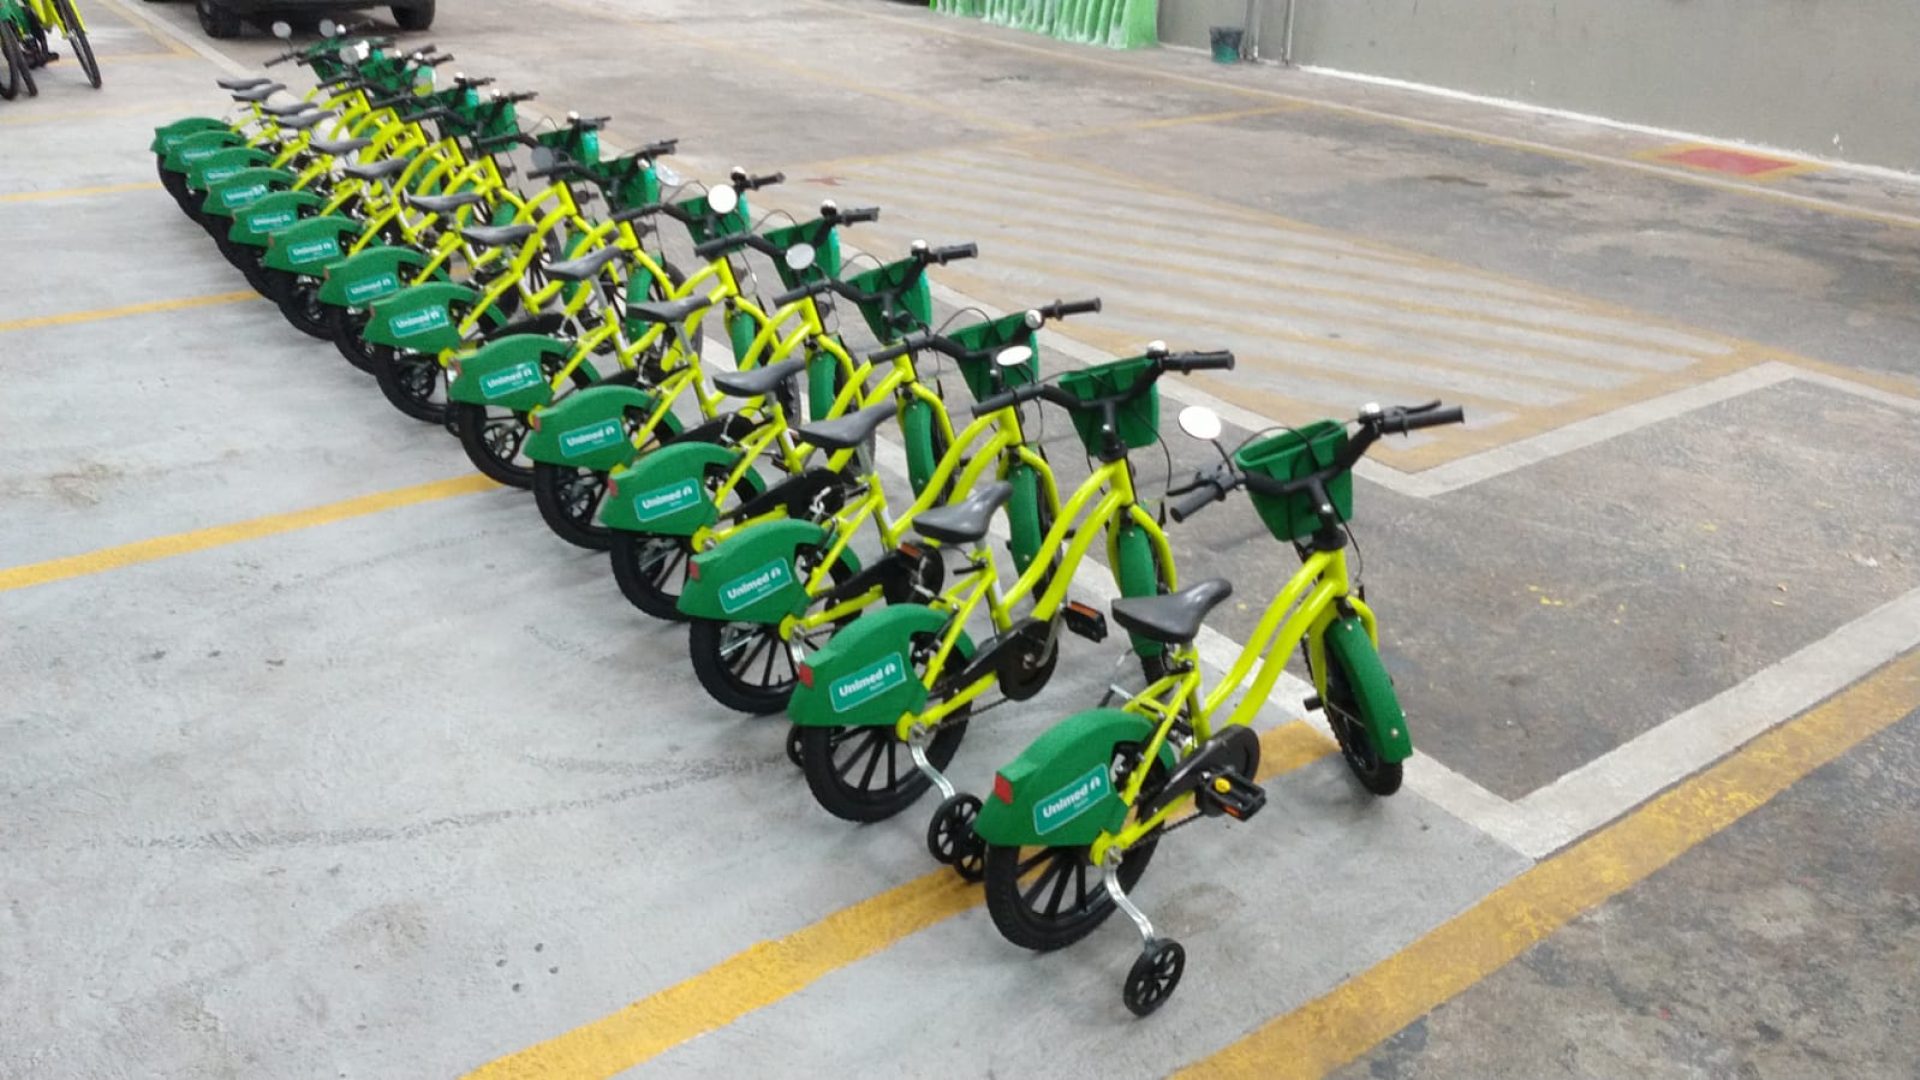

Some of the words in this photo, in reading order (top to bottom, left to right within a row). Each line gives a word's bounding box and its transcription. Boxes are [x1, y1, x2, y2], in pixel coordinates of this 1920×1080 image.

[566, 427, 604, 447] Unimed
[641, 489, 682, 510] Unimed
[726, 571, 770, 600] Unimed
[838, 667, 884, 697] Unimed
[1042, 783, 1089, 818] Unimed
